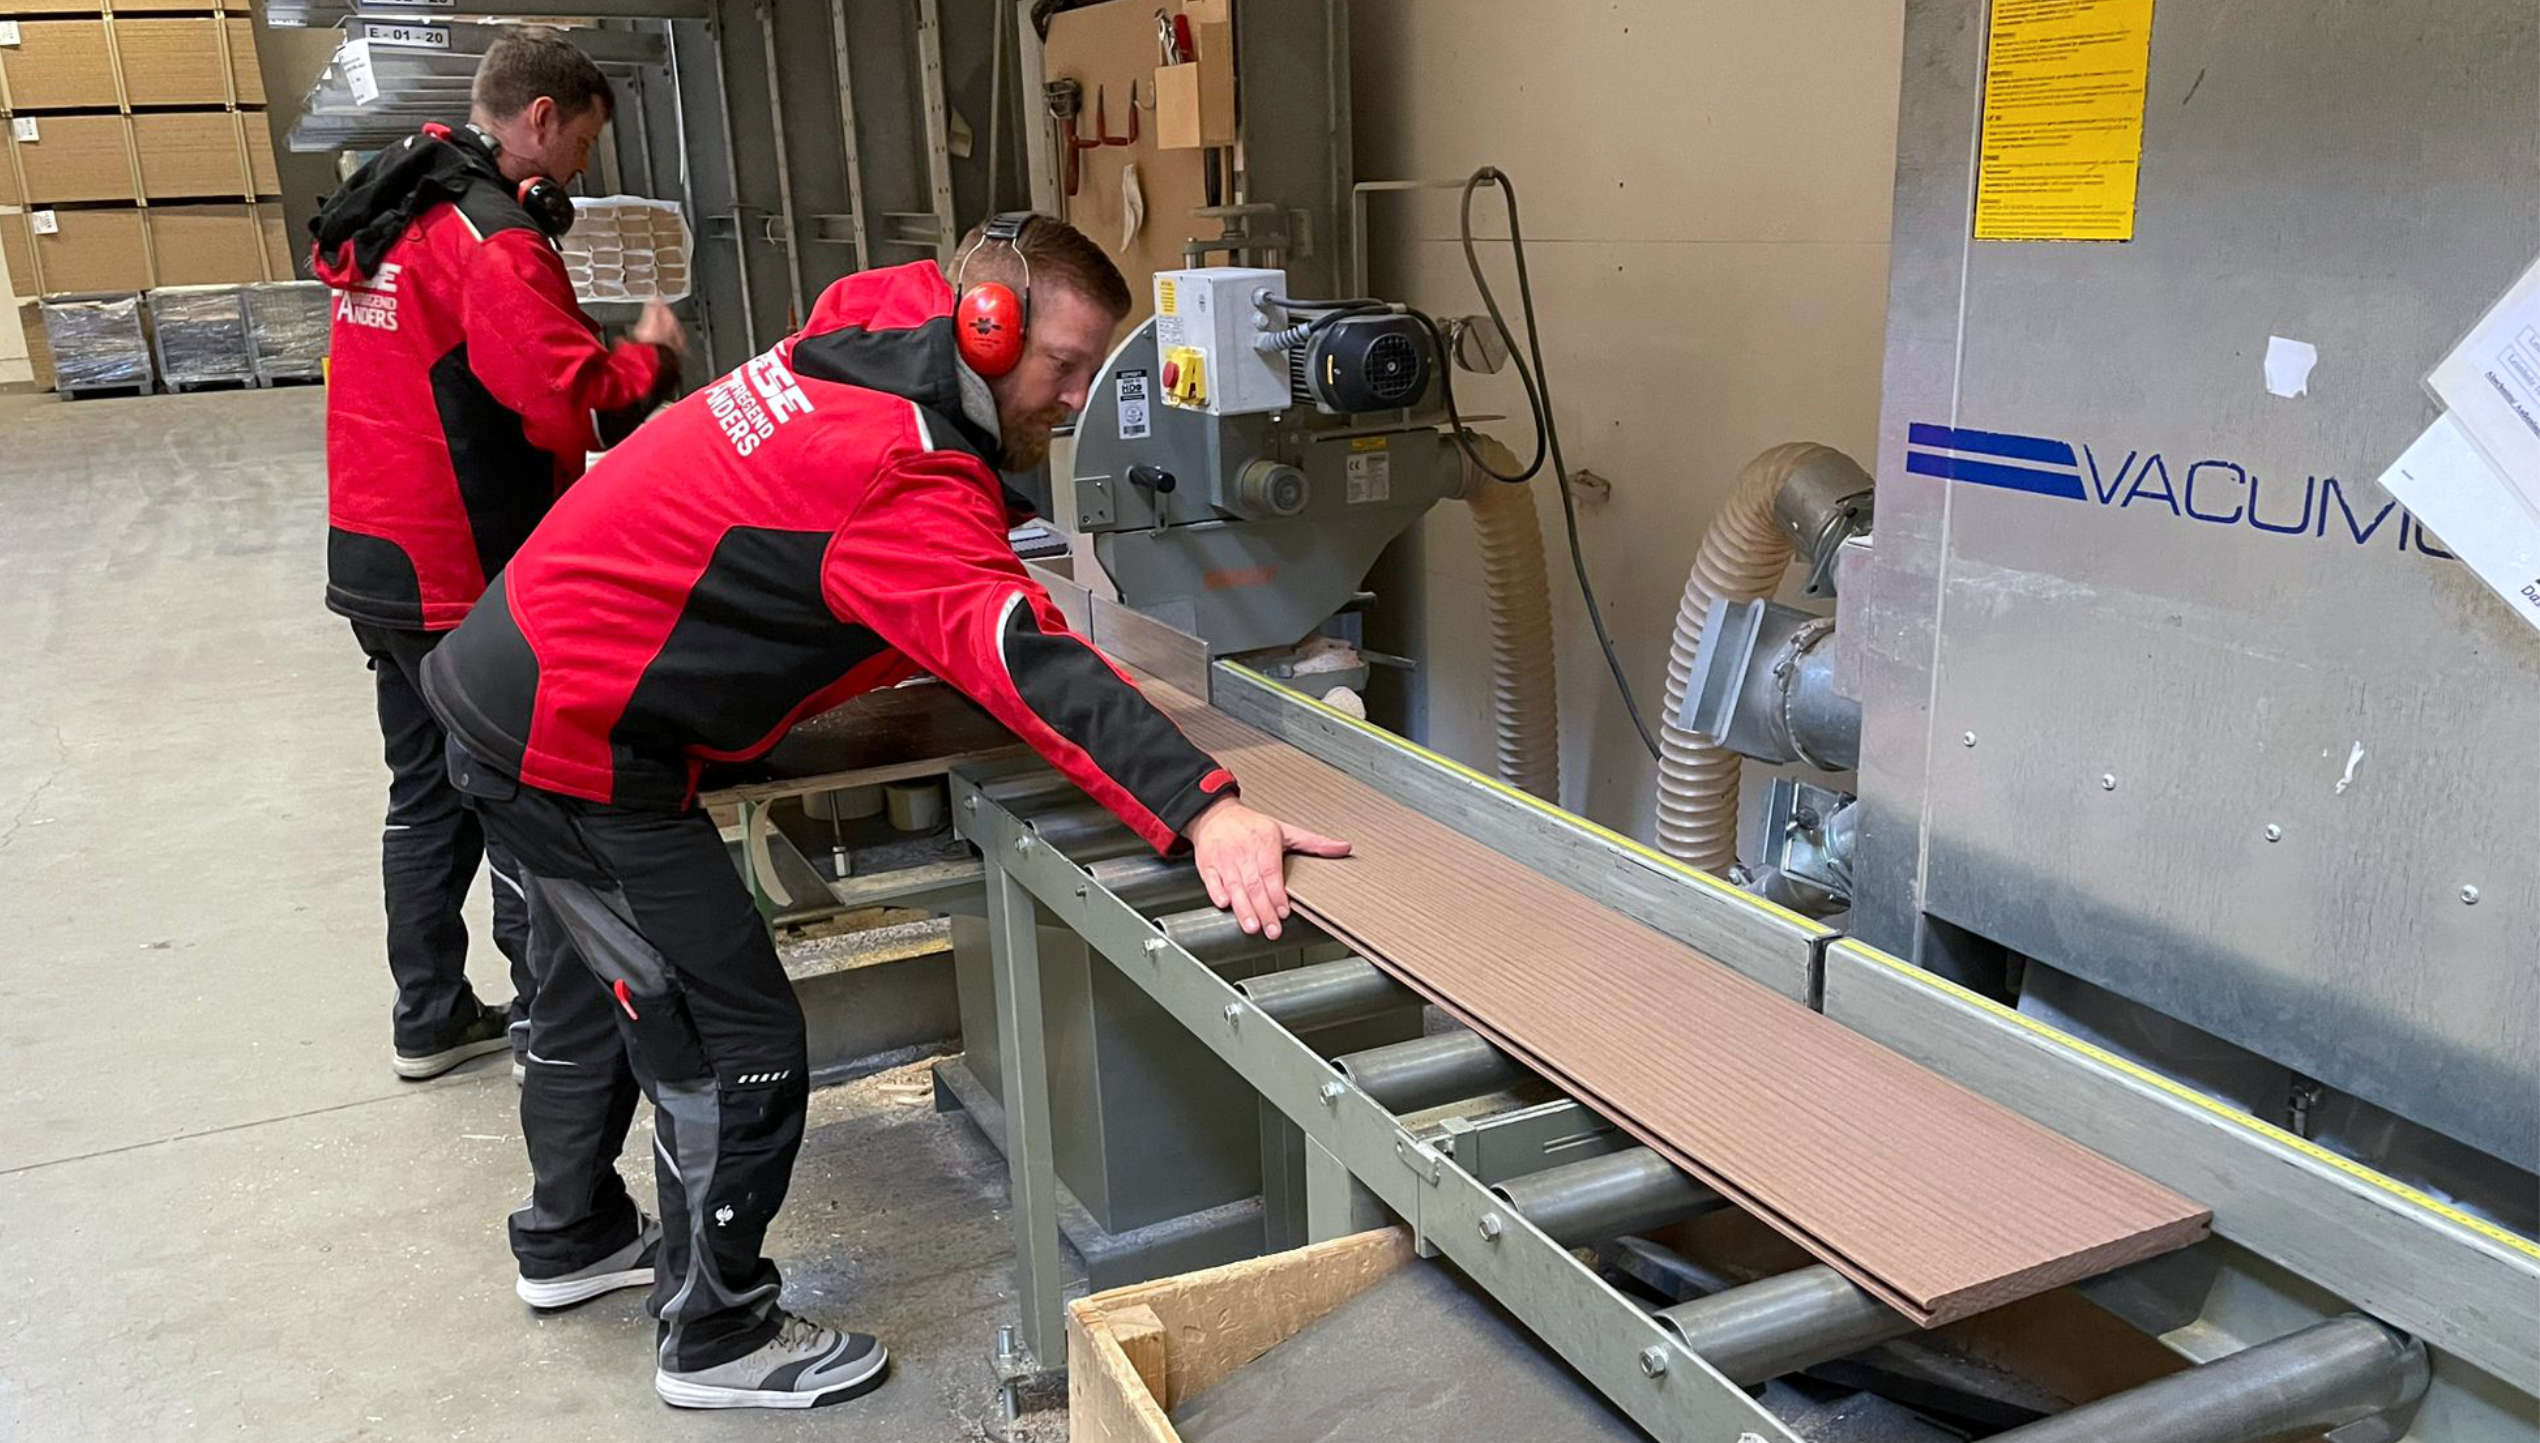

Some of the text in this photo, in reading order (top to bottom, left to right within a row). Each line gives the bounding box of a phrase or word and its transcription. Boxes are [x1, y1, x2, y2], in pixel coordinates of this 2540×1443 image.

[369, 27, 379, 38] E
[393, 29, 410, 41] 01
[425, 31, 443, 43] 20
[336, 289, 399, 332] ANDERS
[704, 379, 762, 457] ANDERS
